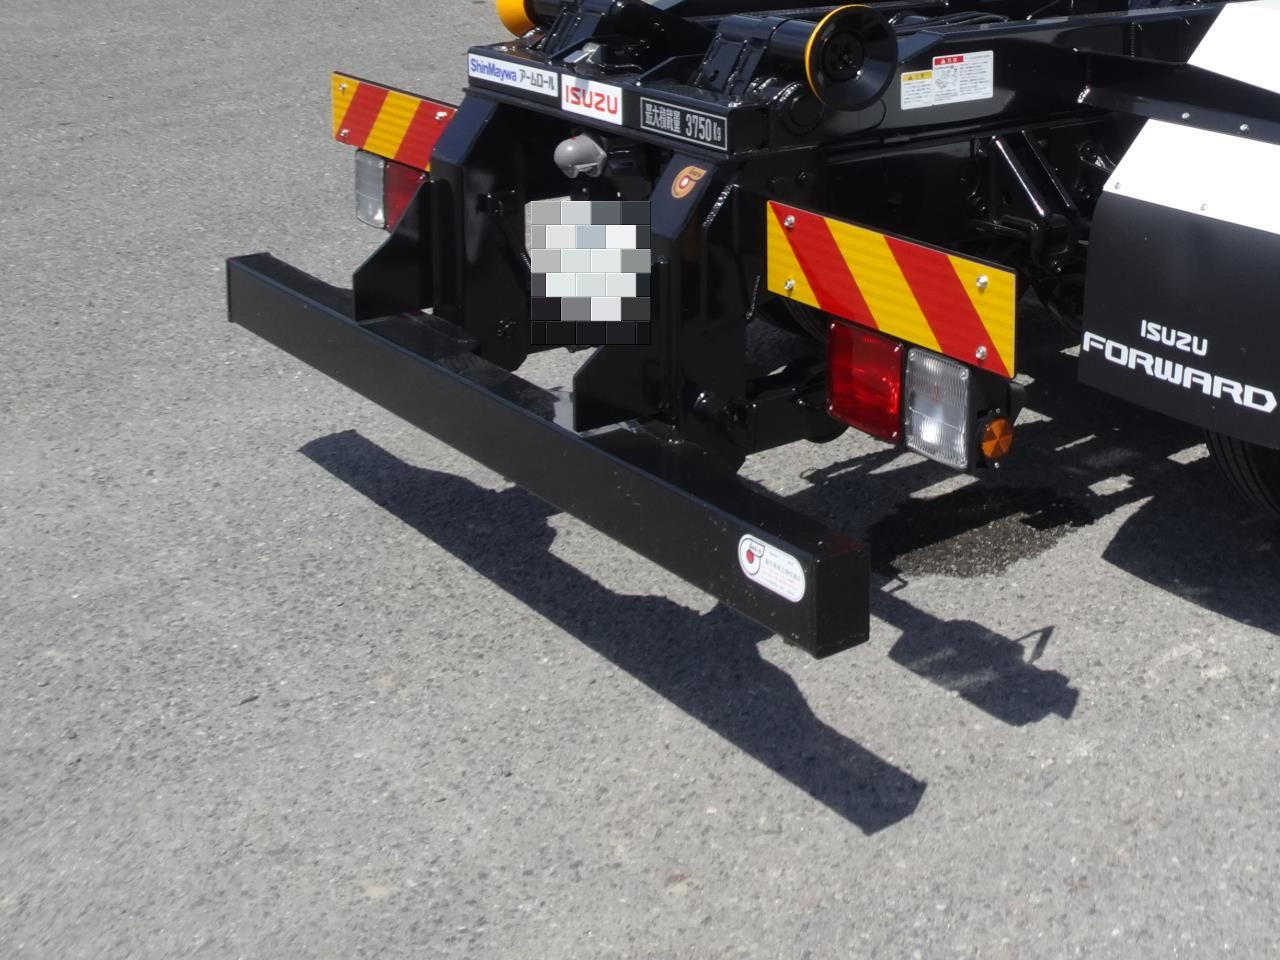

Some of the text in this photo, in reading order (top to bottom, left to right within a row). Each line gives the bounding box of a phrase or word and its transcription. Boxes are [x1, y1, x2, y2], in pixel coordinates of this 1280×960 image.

[470, 58, 555, 91] ShinMaywa アームロール
[565, 85, 618, 115] ISUZU
[644, 103, 682, 134] 最大積載量
[1140, 319, 1208, 357] ISUZU
[1082, 330, 1278, 414] FORWARD
